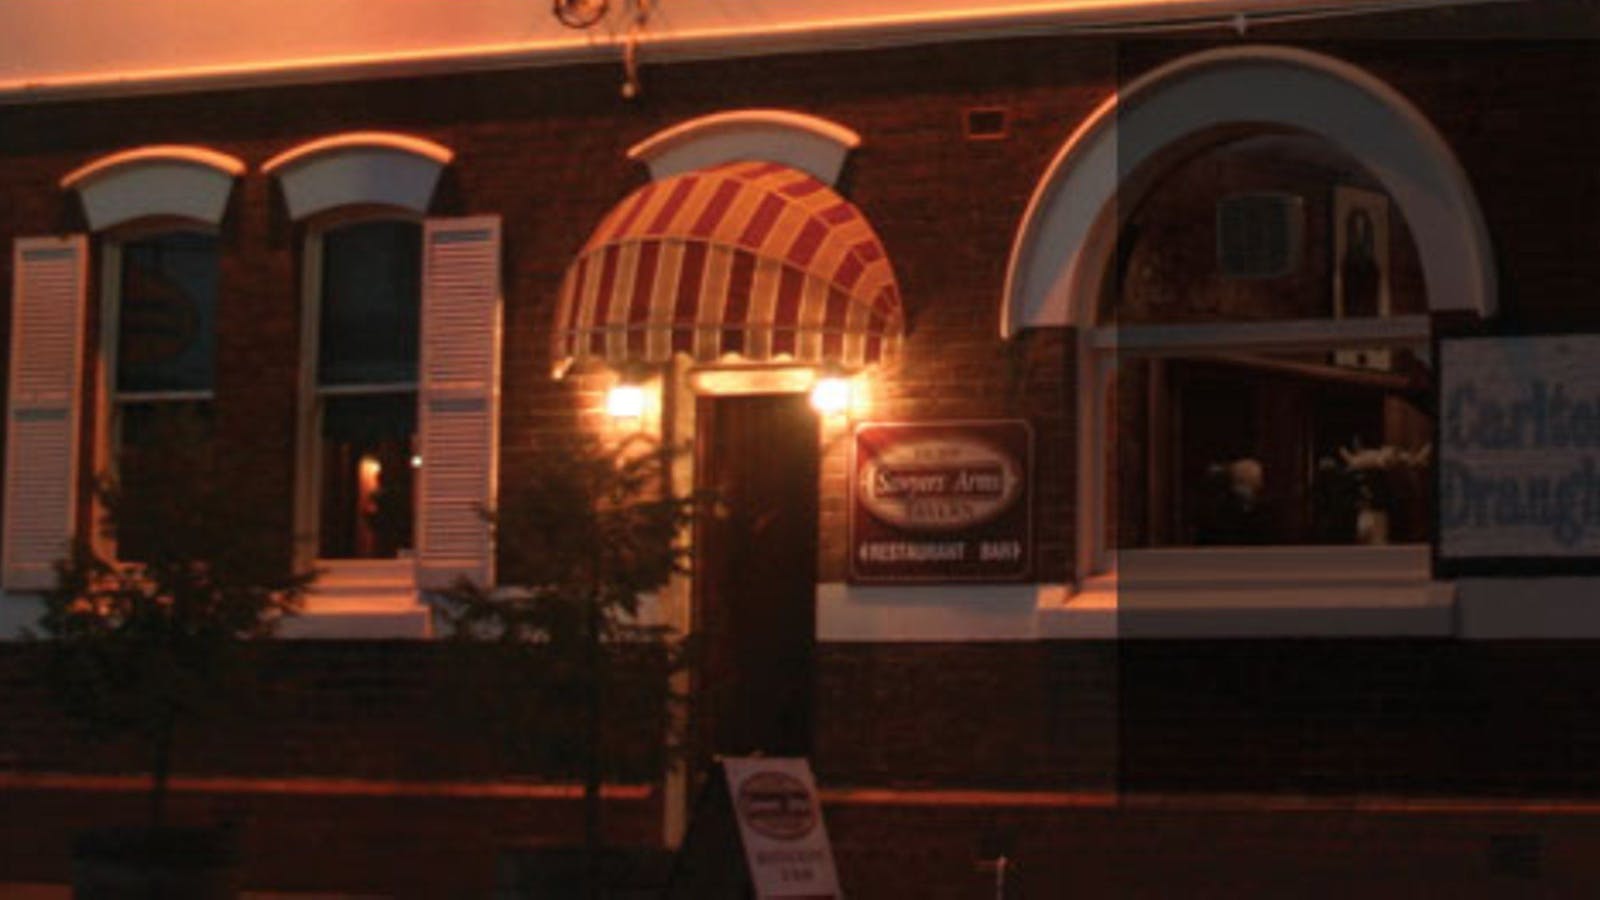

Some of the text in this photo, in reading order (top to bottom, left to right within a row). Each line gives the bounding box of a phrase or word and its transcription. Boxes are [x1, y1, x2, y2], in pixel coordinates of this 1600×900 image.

[878, 468, 1003, 497] Sawyers Arms
[869, 541, 1015, 563] RESTAURANT BAR
